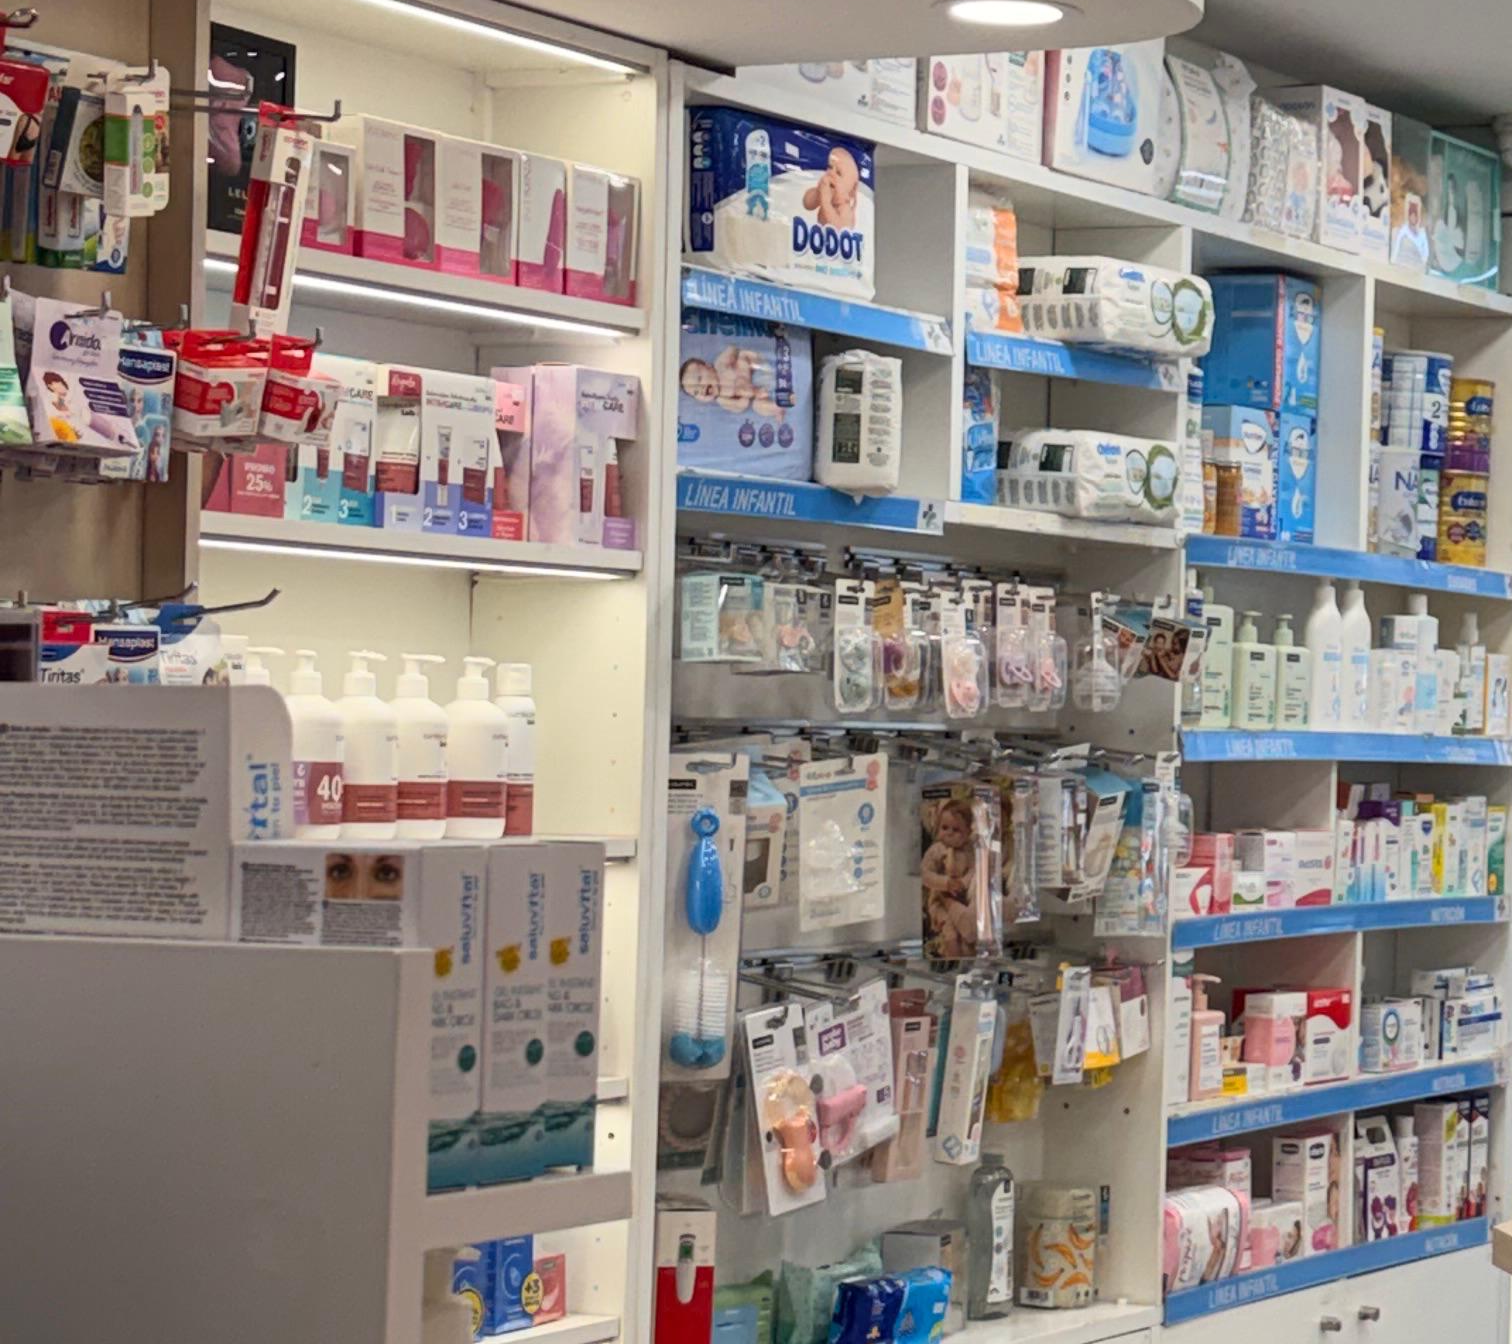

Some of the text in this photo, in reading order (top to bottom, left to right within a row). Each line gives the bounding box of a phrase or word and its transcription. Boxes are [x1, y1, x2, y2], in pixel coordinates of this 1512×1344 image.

[227, 187, 248, 199] LEL
[793, 216, 864, 262] DODOT
[738, 287, 804, 323] INFANTIL
[245, 474, 273, 493] 25%
[303, 496, 312, 515] 2
[684, 478, 796, 517] LÍNEA INFANTIL
[338, 499, 349, 519] 3
[423, 507, 434, 527] 2
[458, 511, 468, 531] 3
[97, 635, 155, 652] Hansaplast
[316, 774, 343, 802] 40
